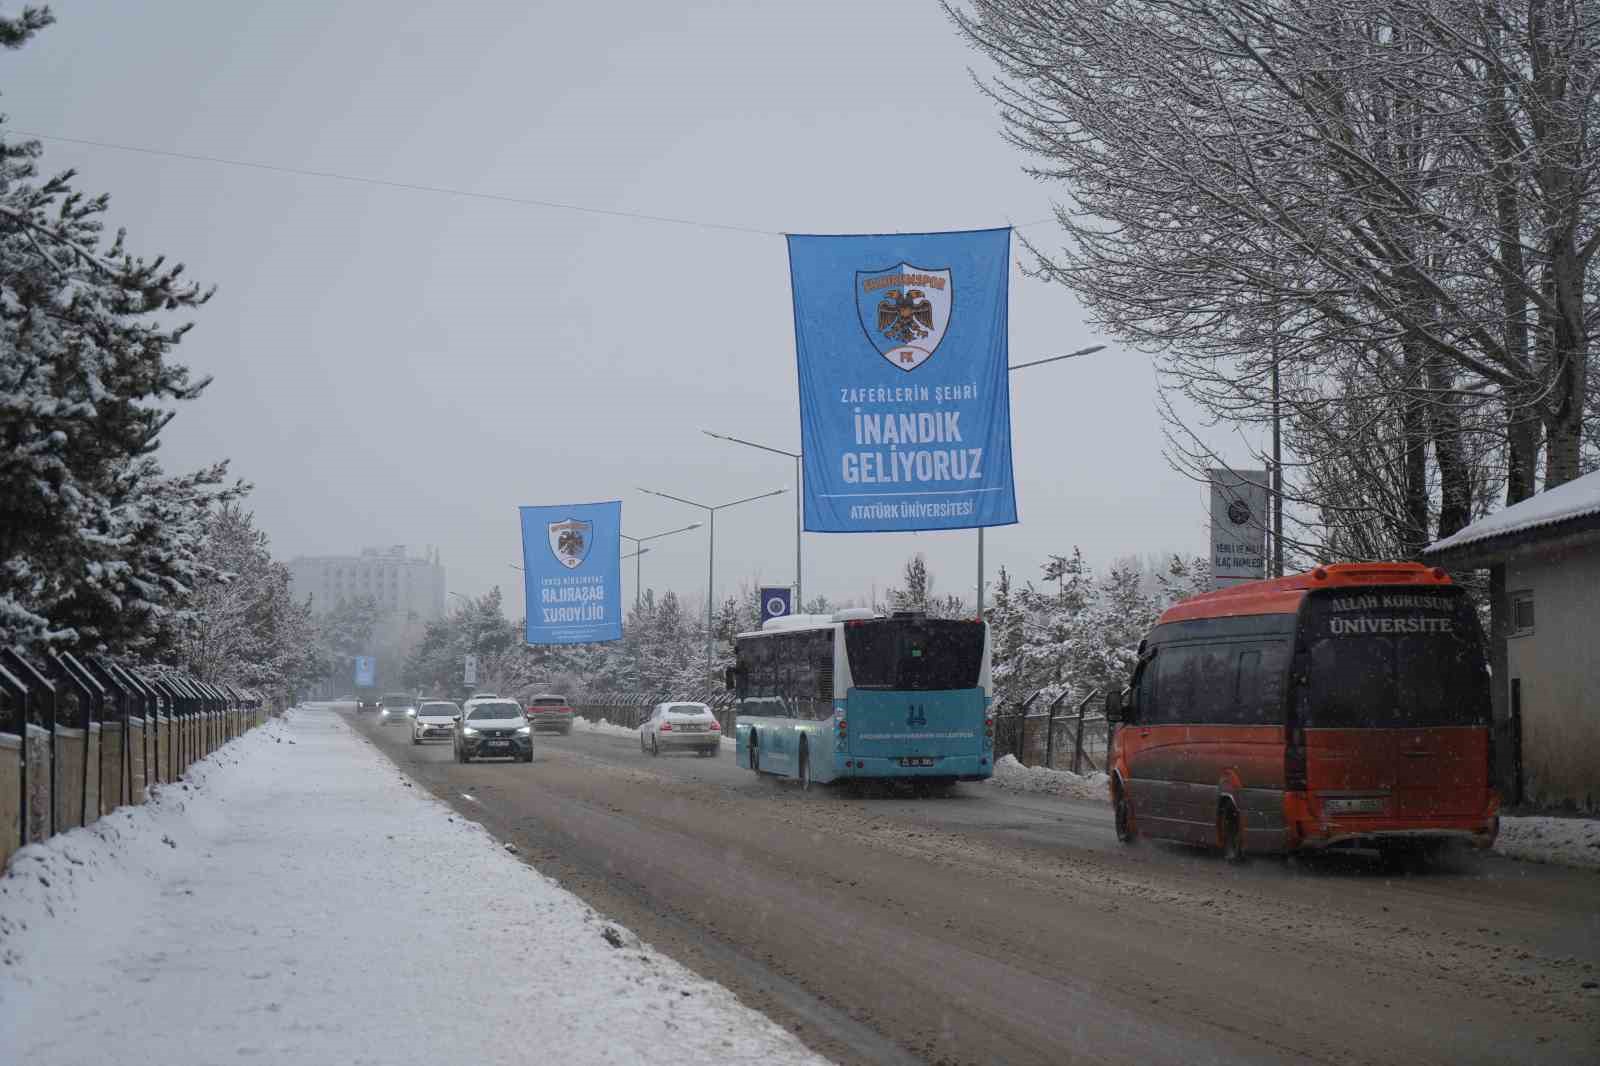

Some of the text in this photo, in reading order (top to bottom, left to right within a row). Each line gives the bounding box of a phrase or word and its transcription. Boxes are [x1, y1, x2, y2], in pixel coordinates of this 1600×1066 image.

[840, 382, 977, 405] ZAFERLERİN ŞEHRİ
[854, 407, 962, 445] İNANDIK
[842, 444, 983, 484] GELİYORUZ
[850, 500, 974, 520] ATATÜRK ÜNİVERSİTESİ
[1331, 592, 1454, 612] ALLAH KORUSUN
[1329, 615, 1454, 634] ÜNİVERSİTE
